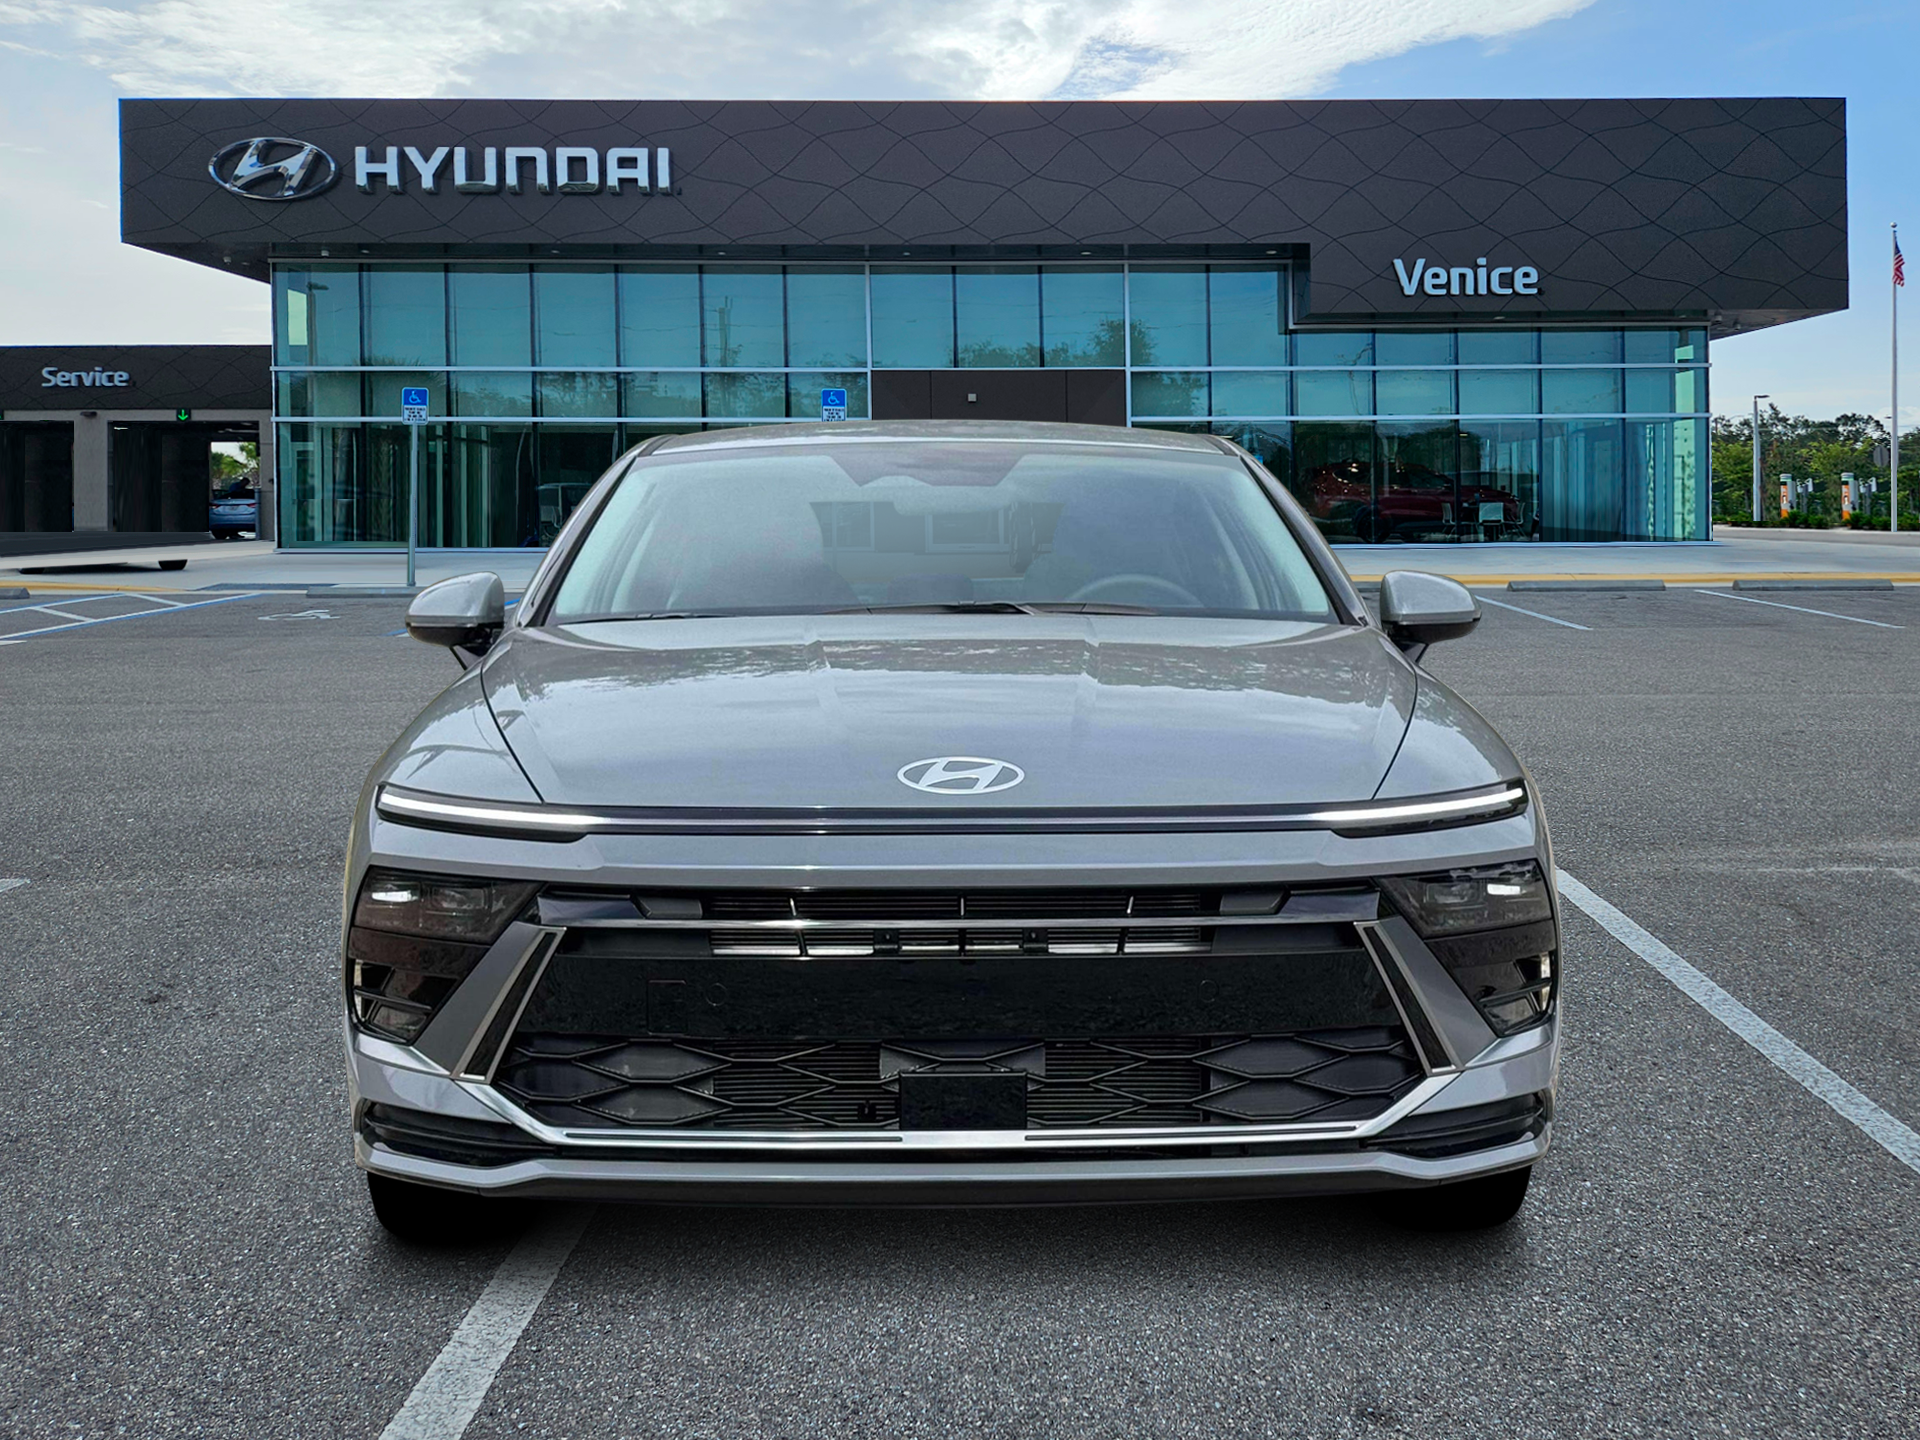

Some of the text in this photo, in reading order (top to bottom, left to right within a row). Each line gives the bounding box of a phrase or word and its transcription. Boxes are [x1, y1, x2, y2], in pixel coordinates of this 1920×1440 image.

[355, 146, 672, 193] HYUNDAI
[1393, 257, 1539, 296] Venice
[41, 366, 130, 387] Service
